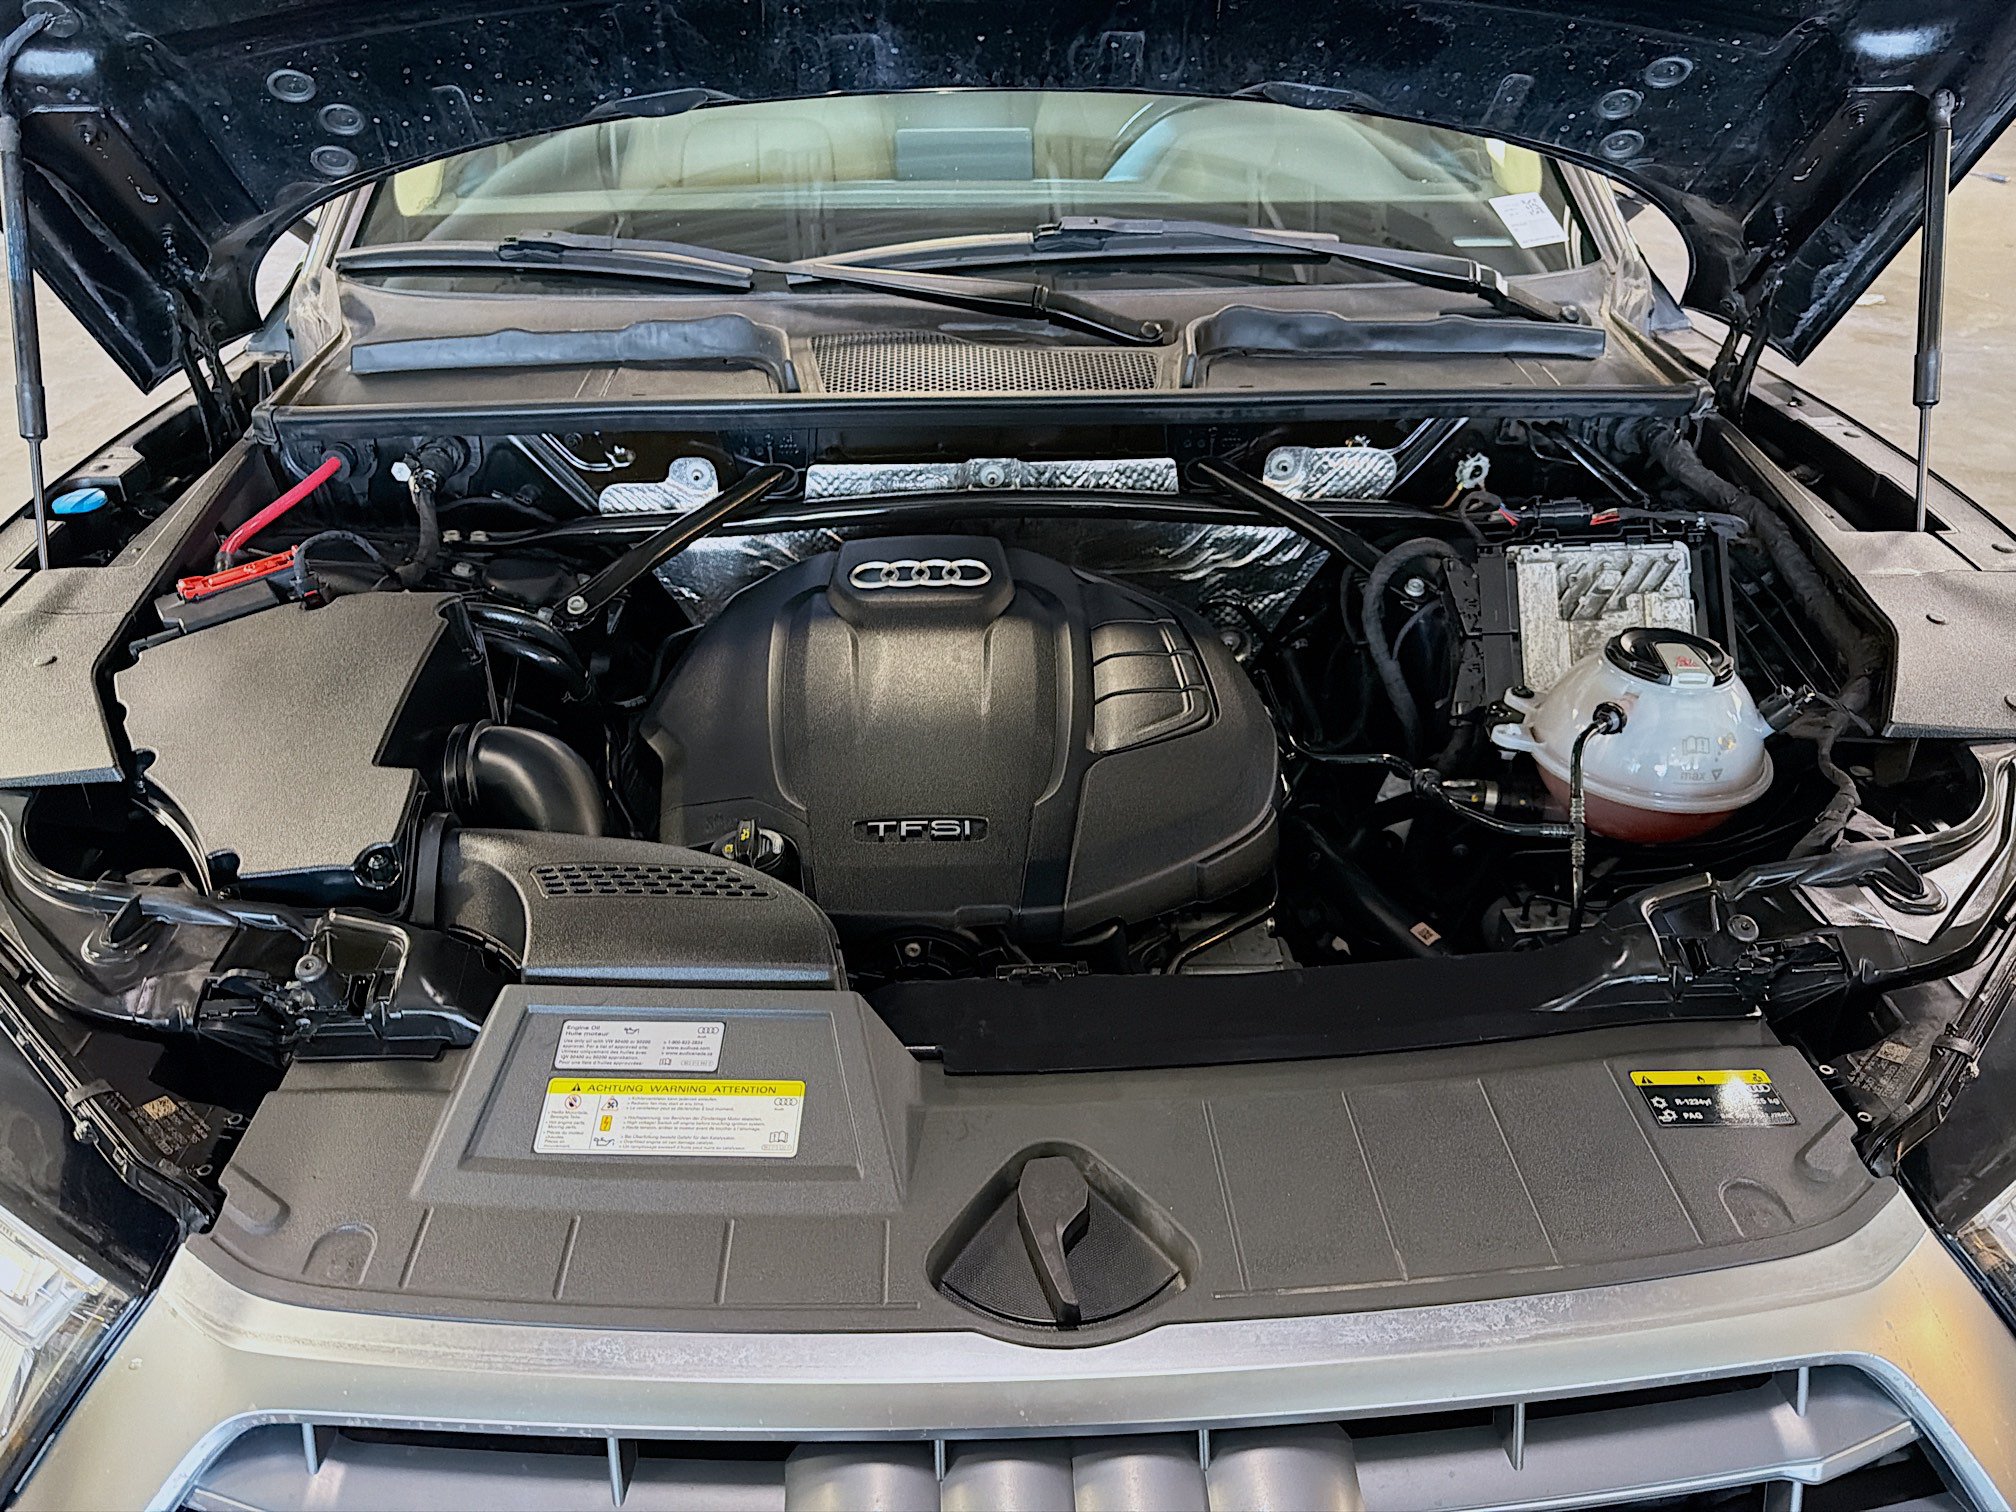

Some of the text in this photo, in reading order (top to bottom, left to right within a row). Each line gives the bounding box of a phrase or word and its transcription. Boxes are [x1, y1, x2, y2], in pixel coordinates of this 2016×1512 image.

[1680, 771, 1705, 781] max
[867, 820, 971, 837] TFSI
[587, 1084, 777, 1094] ACHTUNG WARNING ATTENTION
[1682, 1111, 1704, 1120] PAG
